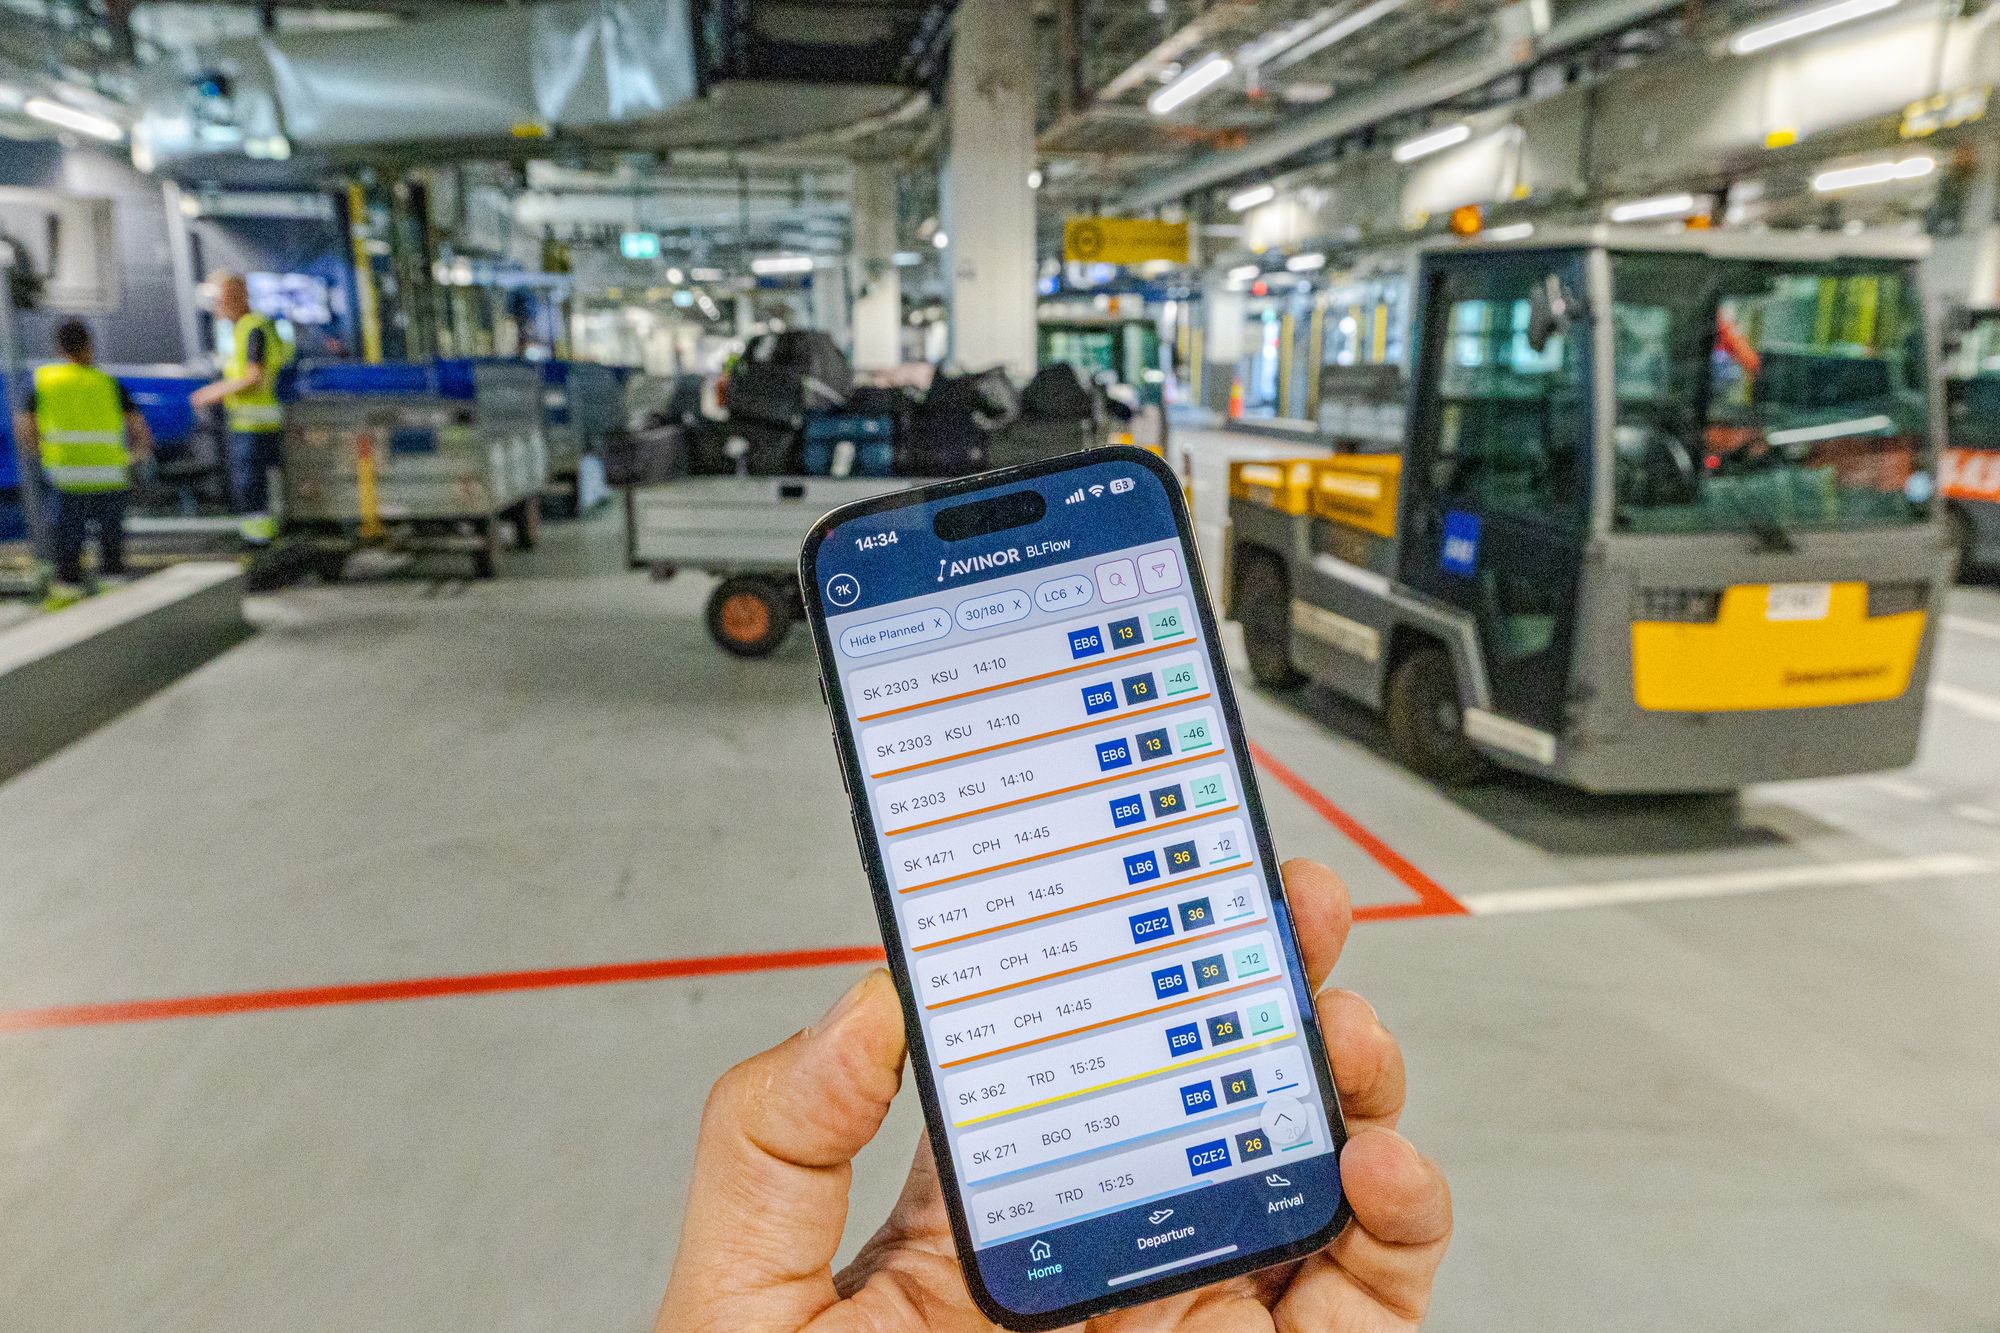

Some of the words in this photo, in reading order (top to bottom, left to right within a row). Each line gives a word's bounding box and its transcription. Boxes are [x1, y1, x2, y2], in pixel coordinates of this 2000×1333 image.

[1115, 481, 1129, 492] 53
[856, 531, 898, 551] 14:34
[950, 548, 1021, 578] AVINOR
[1026, 540, 1070, 557] BLFlow
[850, 635, 876, 647] Hide
[879, 622, 924, 640] Planned
[966, 604, 1004, 620] 30/180
[1044, 588, 1068, 603] LC6
[863, 686, 882, 701] SK
[885, 678, 918, 695] 2303
[931, 669, 958, 684] KSU
[973, 658, 1006, 674] 14:10
[1073, 635, 1099, 651] EB6
[1118, 626, 1134, 640] 13
[1154, 615, 1177, 628] -46
[876, 743, 895, 758] SK
[898, 735, 932, 752] 2303
[945, 725, 972, 740] KSU
[987, 714, 1020, 730] 14:10
[1087, 690, 1113, 707] EB6
[1132, 682, 1148, 695] 13
[1168, 670, 1191, 683] -46
[890, 800, 909, 815] SK
[912, 792, 945, 809] 2303
[959, 782, 985, 797] KSU
[1001, 770, 1033, 787] 14:10
[1101, 746, 1127, 763] EB6
[1146, 738, 1162, 751] 13
[1182, 726, 1205, 739] -46
[903, 858, 923, 873] SK
[926, 850, 954, 866] 1471
[973, 839, 1000, 854] CPH
[1015, 826, 1050, 843] 14:45
[1115, 803, 1141, 819] EB6
[1159, 793, 1177, 808] 36
[1197, 782, 1218, 795] -12
[917, 915, 937, 930] SK
[939, 908, 967, 923] 1471
[986, 896, 1014, 912] CPH
[1028, 883, 1064, 901] 14:45
[1128, 859, 1154, 876] LB6
[1173, 850, 1191, 865] 36
[1212, 838, 1232, 851] -12
[930, 973, 950, 989] SK
[953, 966, 981, 981] 1471
[1000, 954, 1028, 970] CPH
[1042, 941, 1077, 958] 14:45
[1135, 917, 1168, 934] OZE2
[1187, 907, 1205, 922] 36
[1226, 895, 1246, 908] -12
[944, 1032, 964, 1047] SK
[967, 1024, 995, 1040] 1471
[1014, 1012, 1042, 1028] CPH
[1056, 998, 1091, 1016] 14:45
[1157, 974, 1183, 991] EB6
[1202, 964, 1219, 979] 36
[1240, 952, 1260, 965] -12
[958, 1090, 978, 1106] SK
[980, 1082, 1007, 1100] 362
[1028, 1071, 1055, 1086] TRD
[1071, 1057, 1105, 1074] 15:25
[1171, 1031, 1197, 1048] EB6
[1216, 1021, 1233, 1036] 26
[1260, 1011, 1269, 1023] 0
[972, 1149, 992, 1165] SK
[994, 1142, 1017, 1159] 271
[1042, 1129, 1071, 1145] BGO
[1085, 1115, 1120, 1133] 15:30
[1185, 1089, 1212, 1107] EB6
[1231, 1079, 1247, 1094] 61
[1274, 1068, 1284, 1081] 5
[986, 1209, 1006, 1225] SK
[1008, 1201, 1035, 1219] 362
[1056, 1188, 1083, 1204] TRD
[1099, 1174, 1134, 1192] 15:25
[1192, 1148, 1226, 1166] OZE2
[1245, 1137, 1262, 1153] 26
[1268, 1193, 1303, 1213] Arrival
[1028, 1264, 1062, 1280] Home
[1137, 1227, 1194, 1249] Departure
